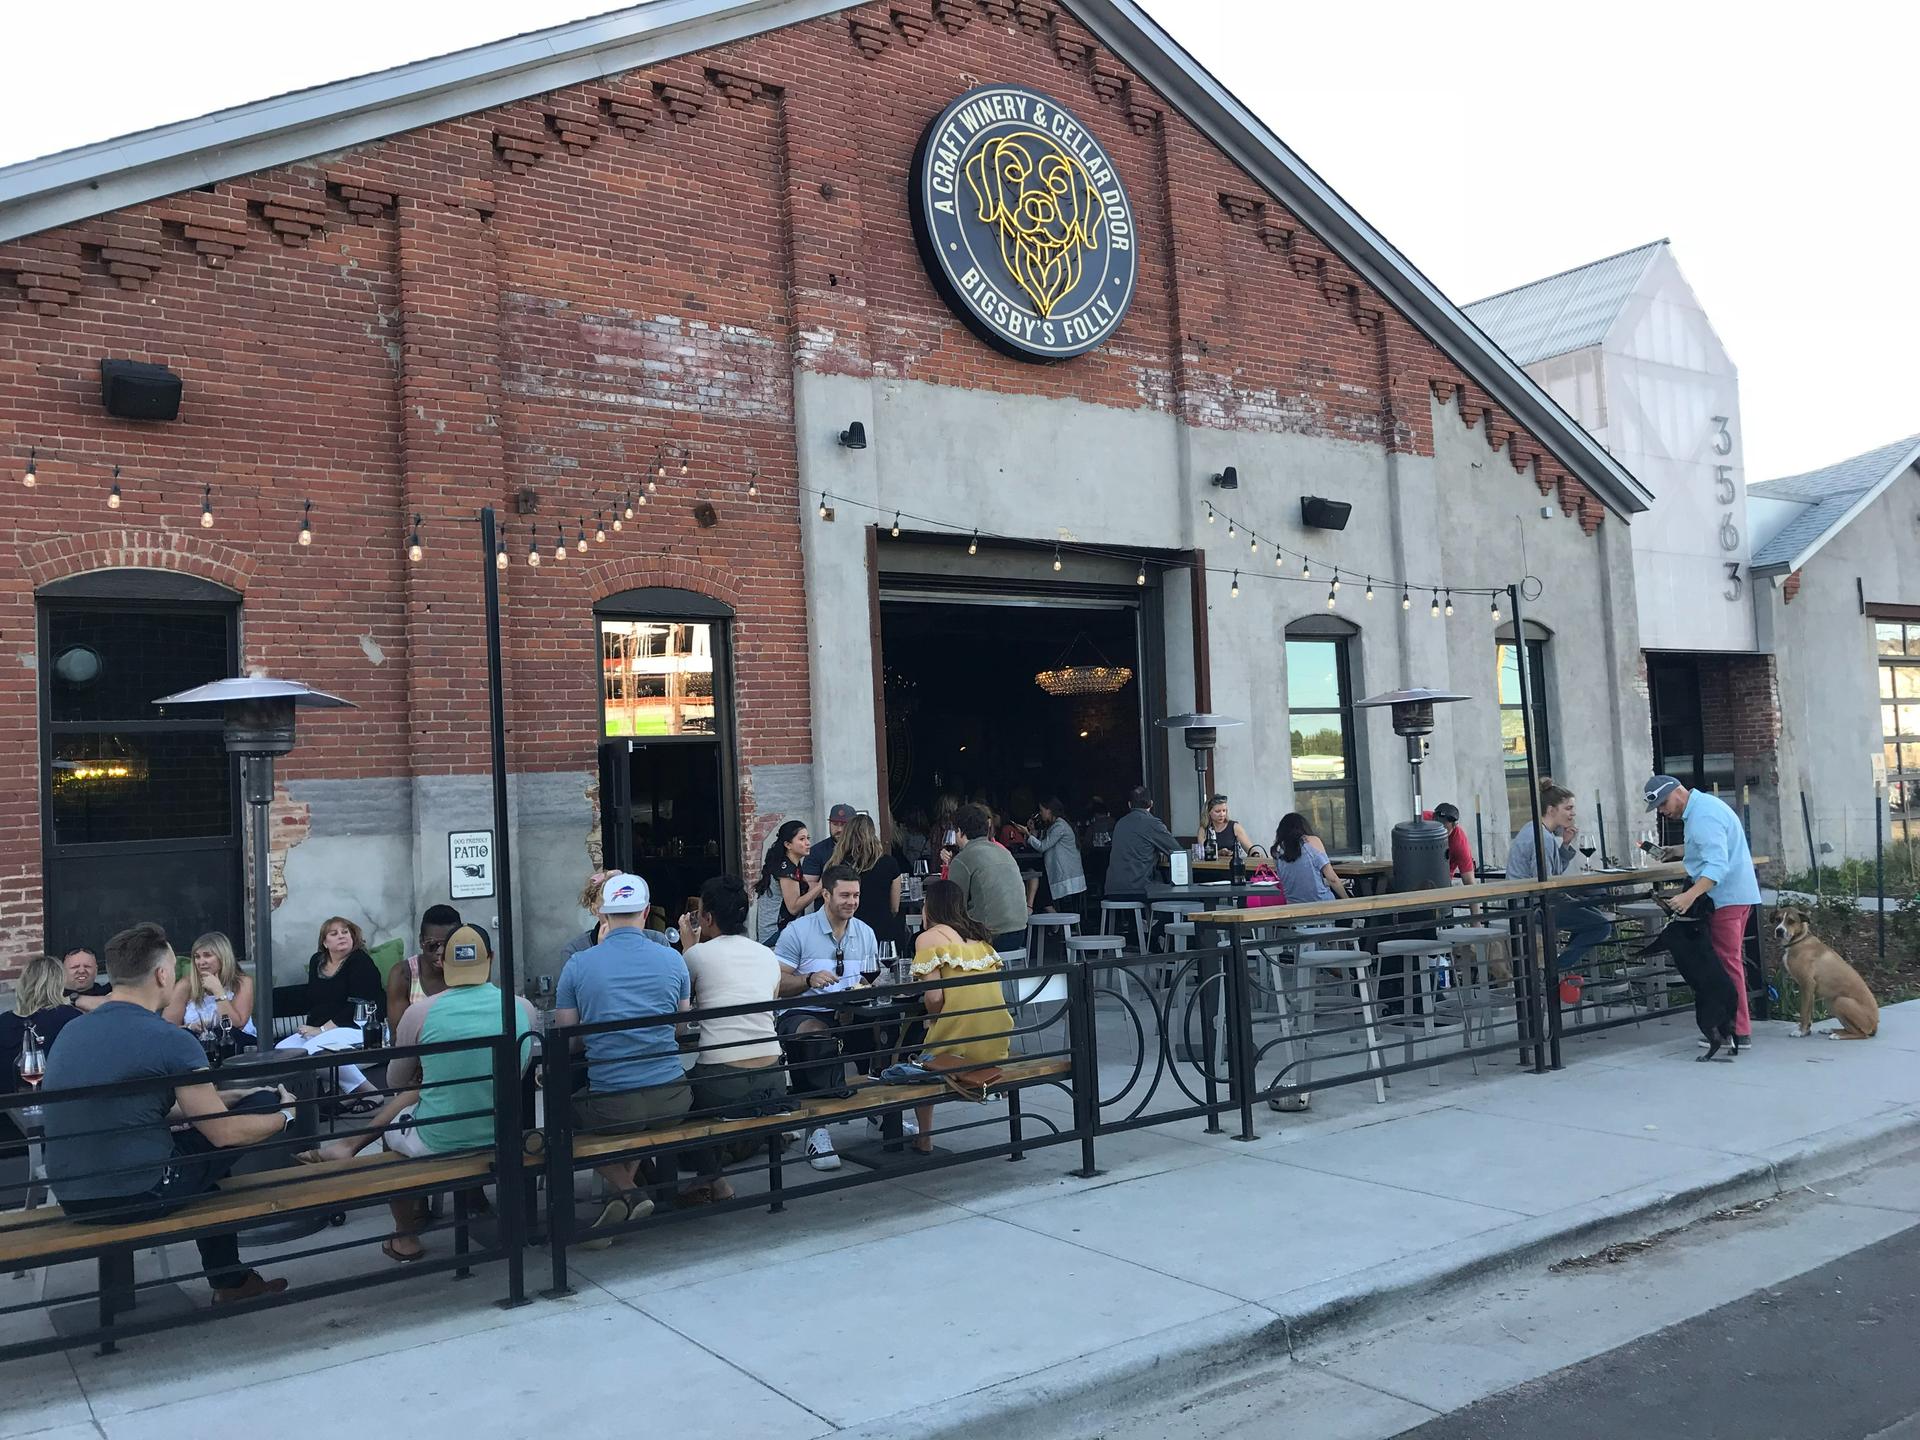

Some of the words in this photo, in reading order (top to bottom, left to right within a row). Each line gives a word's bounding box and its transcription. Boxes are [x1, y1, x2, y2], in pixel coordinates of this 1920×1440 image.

[961, 96, 1027, 132] WINERY
[1033, 103, 1048, 128] &
[933, 123, 966, 194] CRAFT
[1052, 114, 1112, 186] CELLAR
[934, 201, 955, 215] A
[1101, 186, 1129, 251] DOOR
[961, 267, 1056, 345] BIGSBY'S
[1064, 293, 1115, 344] FOLLY
[1711, 416, 1743, 602] 3563
[454, 845, 488, 859] PATIO
